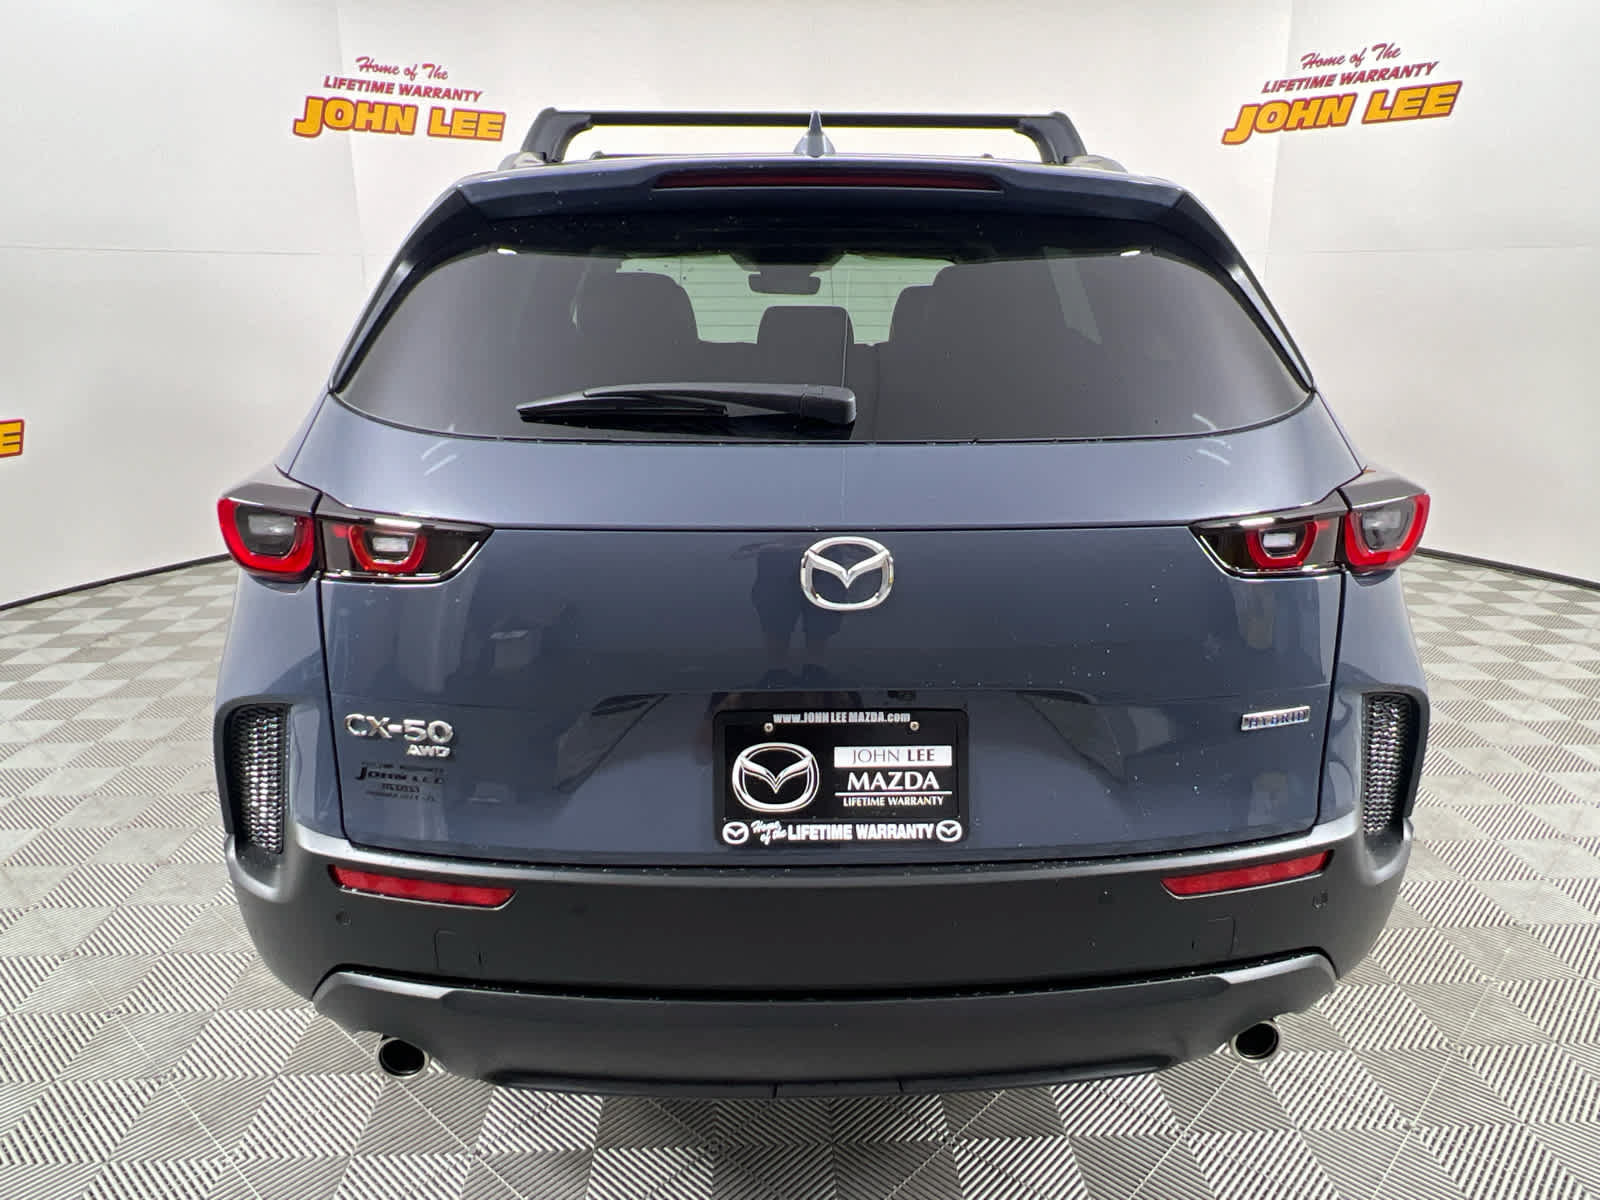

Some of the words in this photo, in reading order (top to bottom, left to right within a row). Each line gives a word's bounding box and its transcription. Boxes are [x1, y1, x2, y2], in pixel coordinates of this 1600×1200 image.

[355, 56, 400, 76] Home
[404, 65, 418, 81] of
[422, 63, 448, 80] The
[1301, 52, 1345, 70] Home
[1349, 48, 1367, 65] of
[1371, 42, 1401, 61] The
[323, 75, 395, 95] LIFETIME
[399, 82, 483, 103] WARRANTY
[1261, 74, 1335, 94] LIFETIME
[1338, 61, 1439, 86] WARRANTY
[293, 96, 419, 138] JOHN
[427, 106, 506, 141] LEE
[1222, 92, 1358, 145] JOHN
[1361, 80, 1463, 124] LEE
[344, 713, 454, 743] CX-50
[1248, 710, 1306, 729] HYBRID
[406, 744, 451, 758] AWD
[853, 749, 900, 764] JOHN
[907, 749, 936, 762] LEE
[847, 771, 940, 791] MAZDA
[843, 797, 886, 807] LIFETIME
[888, 796, 944, 806] WARRANTY
[787, 824, 853, 841] LIFETIME
[856, 823, 935, 840] WARRANTY
